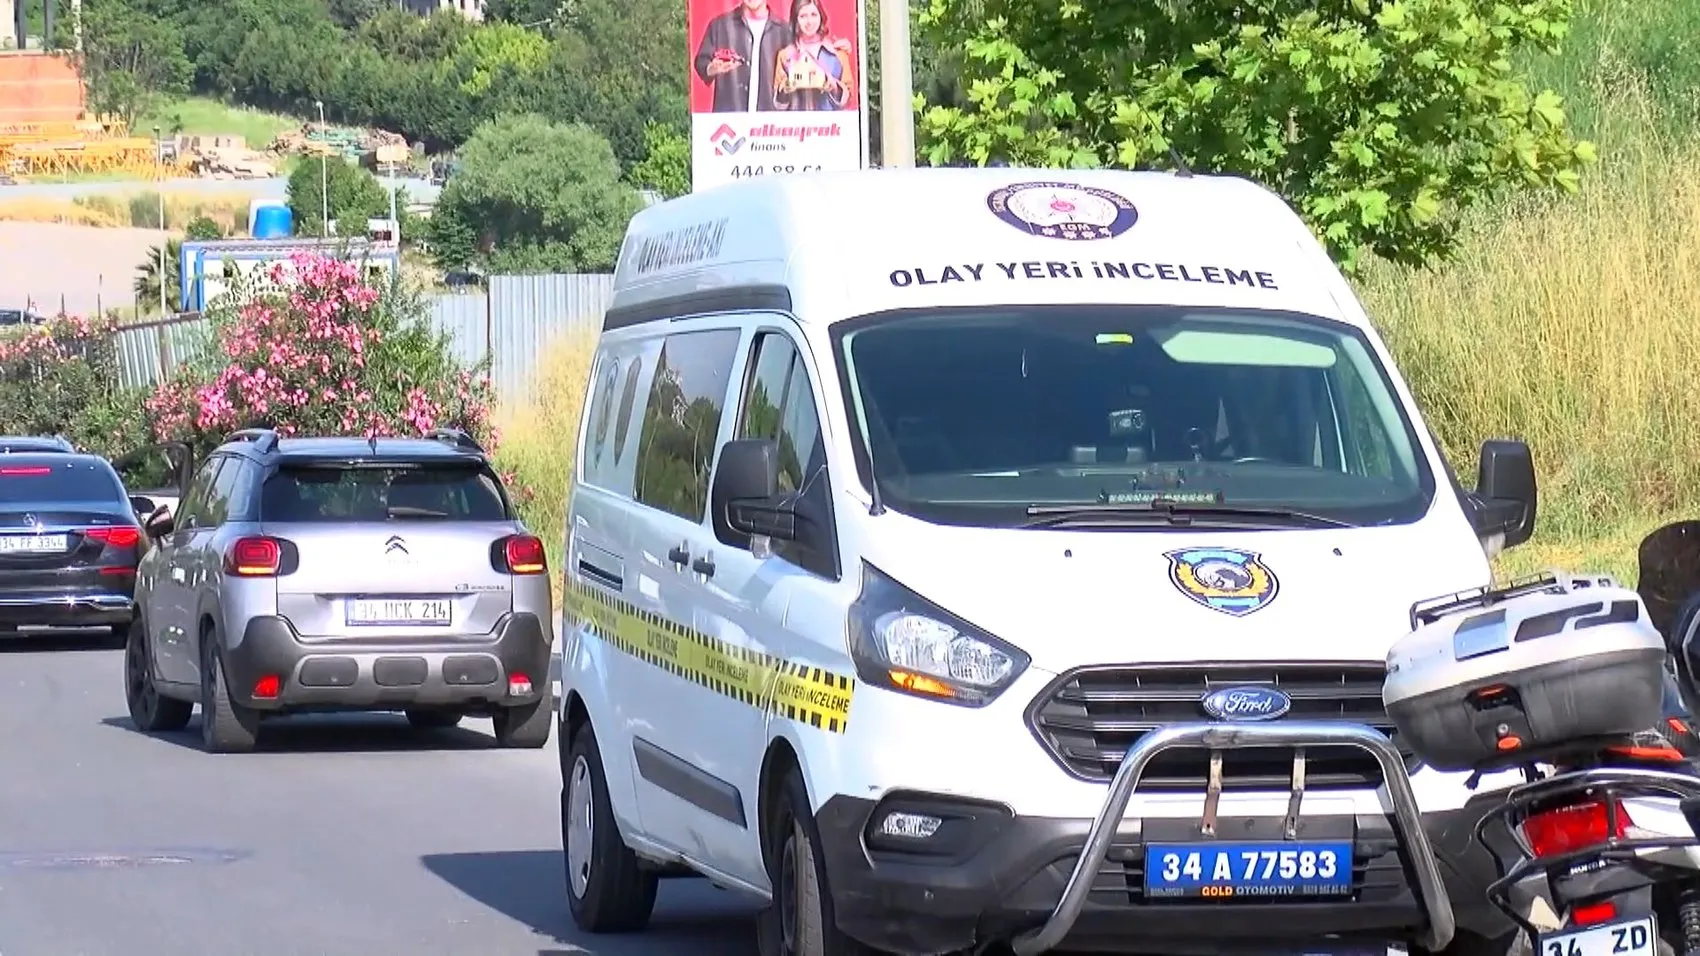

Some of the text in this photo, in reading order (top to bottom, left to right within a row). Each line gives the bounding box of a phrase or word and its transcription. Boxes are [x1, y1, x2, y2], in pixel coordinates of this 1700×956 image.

[750, 142, 786, 152] finans
[889, 263, 985, 288] OLAY
[20, 537, 32, 548] FF
[422, 602, 446, 619] 214
[1225, 691, 1272, 713] Ford
[1162, 850, 1337, 881] 34 A 77583
[1202, 885, 1233, 897] GOLD
[1611, 925, 1647, 955] ZD
